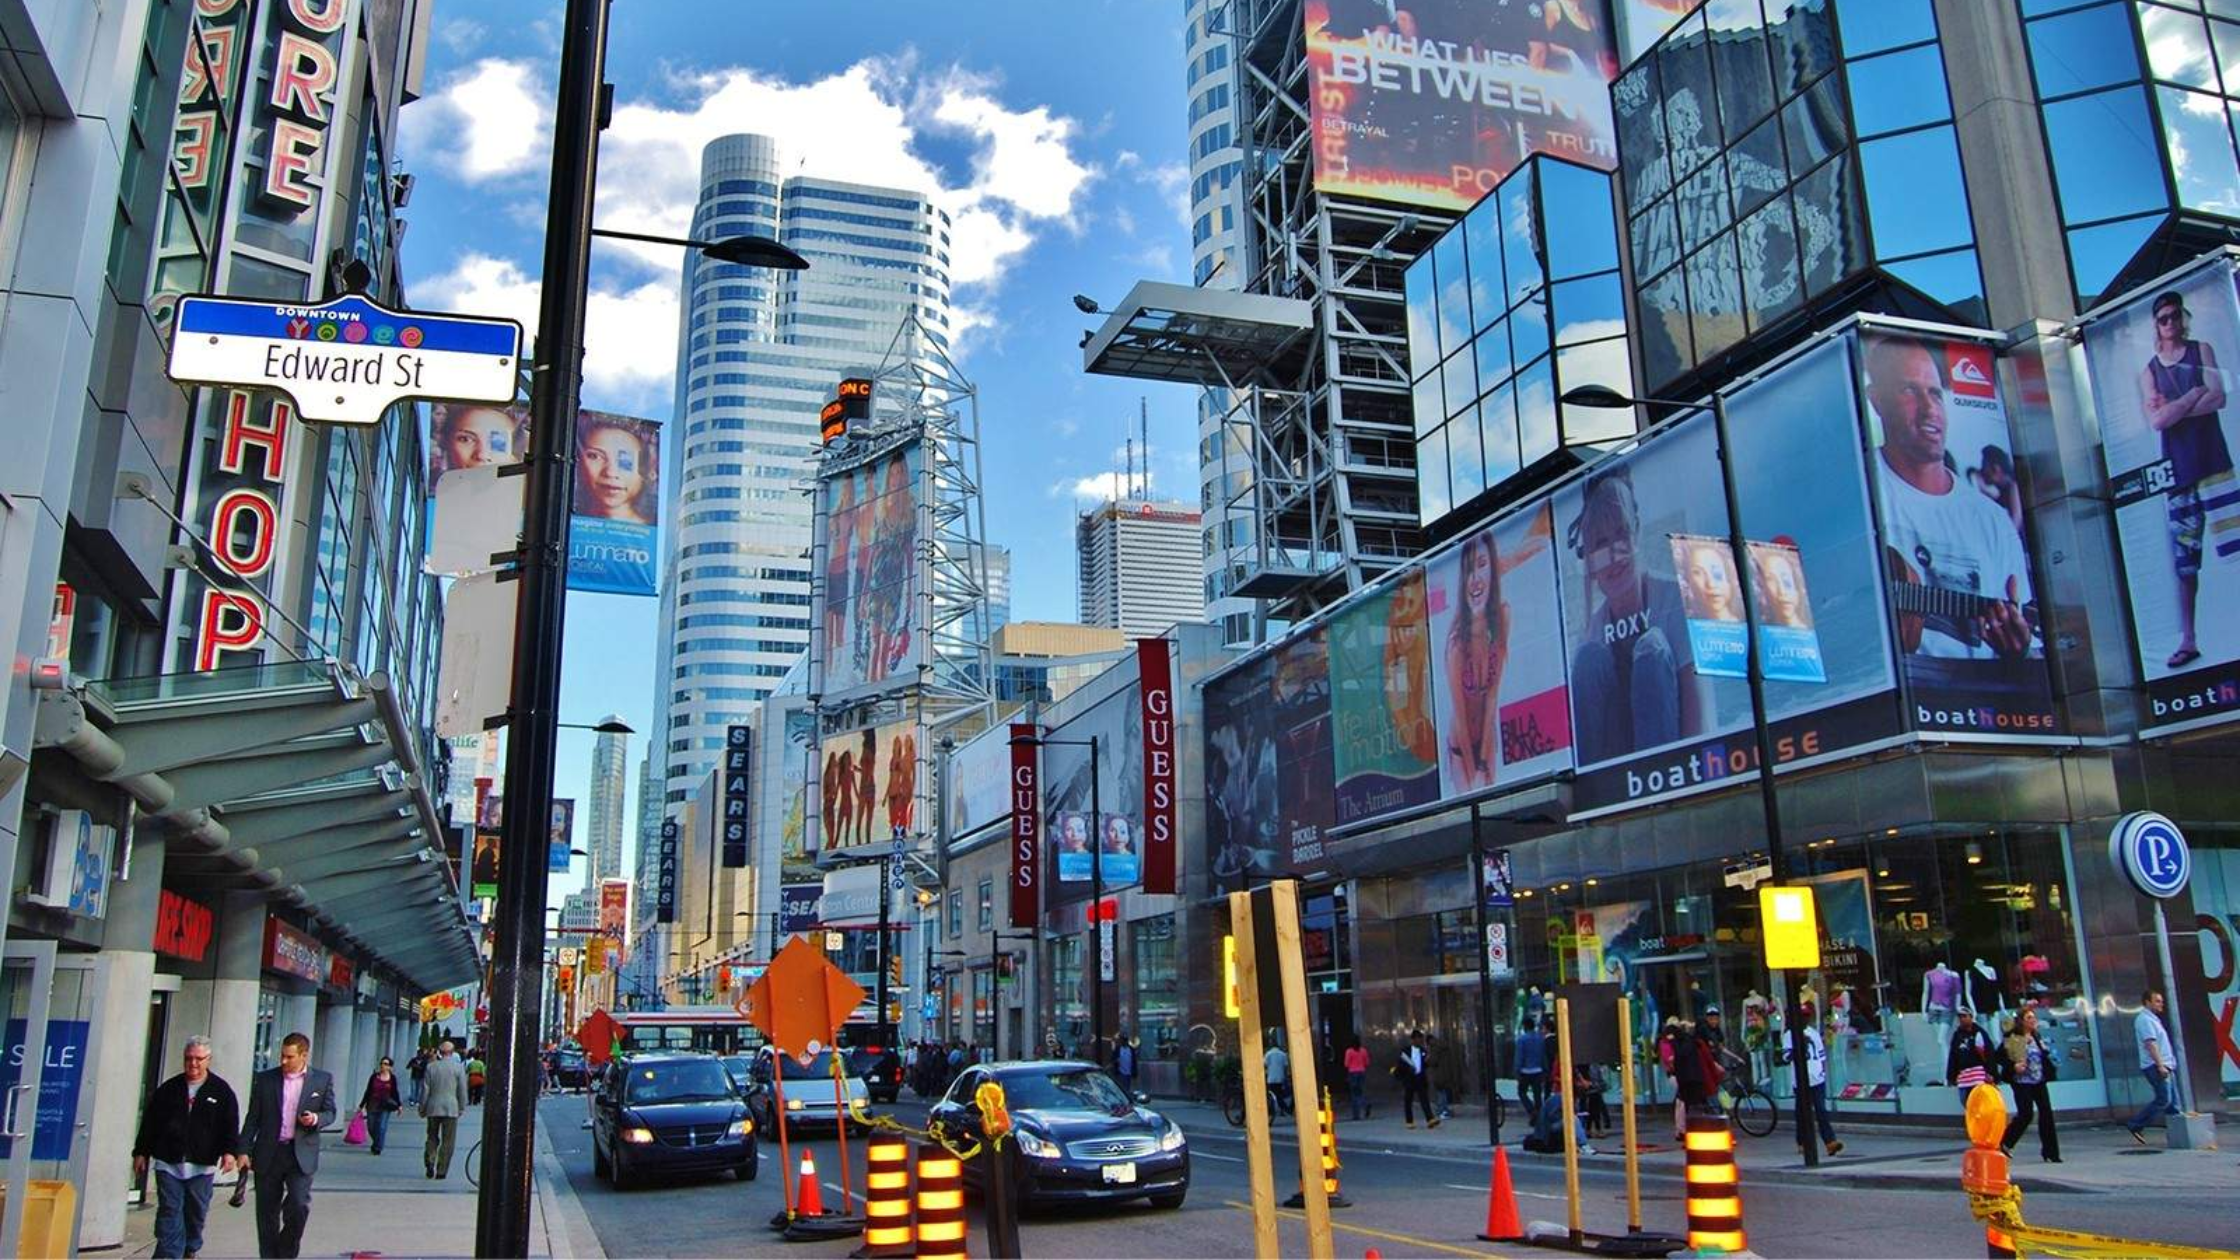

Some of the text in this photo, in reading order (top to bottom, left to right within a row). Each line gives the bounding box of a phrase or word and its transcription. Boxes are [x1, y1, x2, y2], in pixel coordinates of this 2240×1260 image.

[1363, 29, 1529, 71] WHAT LIES
[1330, 41, 1588, 120] BETWEEN
[1321, 117, 1390, 139] BETRAYAL
[275, 307, 361, 321] DOWNTOWN
[264, 344, 424, 388] Edward St
[1604, 608, 1652, 644] ROXY
[1917, 706, 2054, 730] boathouse
[727, 728, 747, 840] SEARS
[1147, 689, 1171, 842] GUESS
[1015, 765, 1033, 888] GUESS
[661, 824, 676, 906] SEARS
[2144, 835, 2171, 876] P
[1823, 953, 1858, 967] BIKINI
[9, 1044, 77, 1068] SLE
